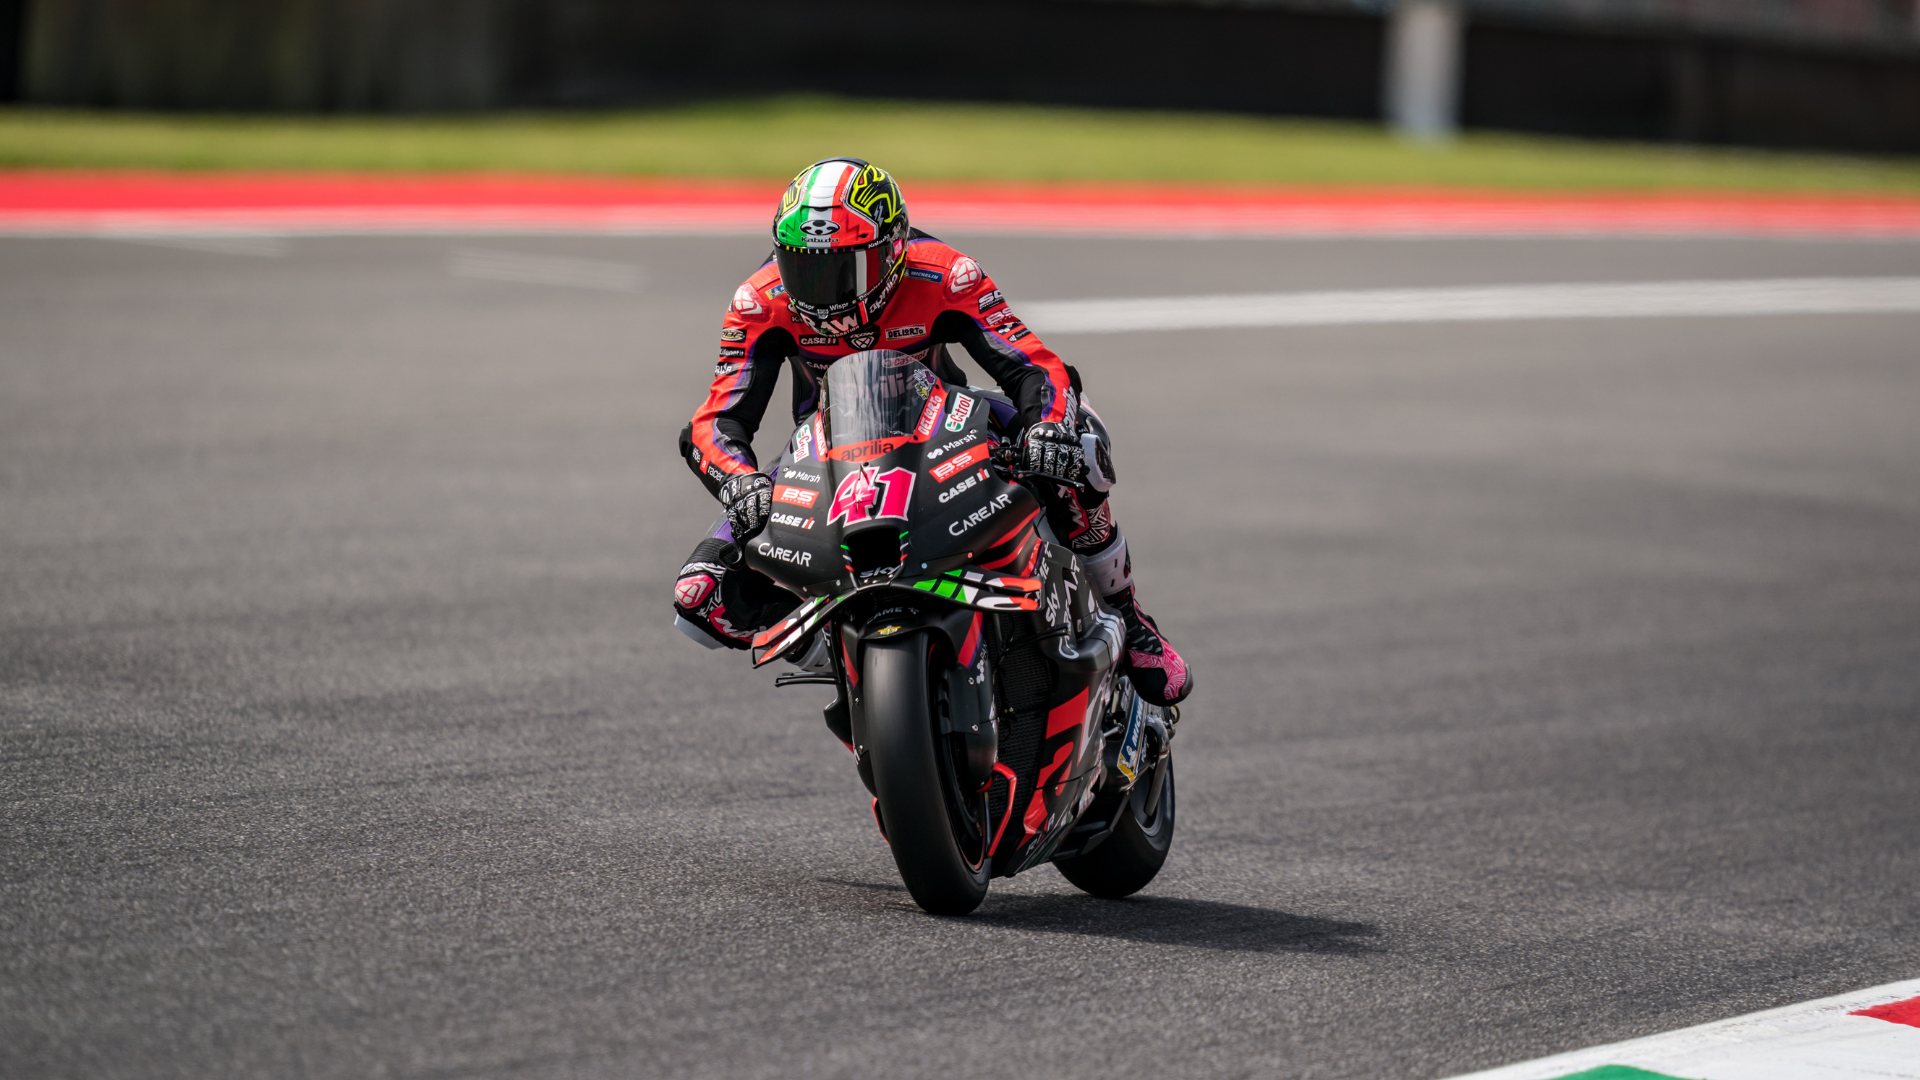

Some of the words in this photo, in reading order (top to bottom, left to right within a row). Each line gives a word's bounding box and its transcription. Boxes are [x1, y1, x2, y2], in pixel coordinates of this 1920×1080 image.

[829, 302, 849, 311] Wispr
[800, 337, 827, 345] CASE
[806, 361, 831, 370] CAM
[942, 434, 977, 451] Marsh
[841, 441, 894, 462] aprilia
[933, 452, 973, 478] BS
[707, 466, 724, 482] racer
[795, 471, 821, 483] Marsh
[782, 487, 816, 502] BS
[826, 466, 917, 528] 41
[938, 475, 977, 503] CASE
[770, 512, 803, 527] CASE
[948, 493, 1012, 536] CAREAR
[758, 542, 812, 567] CAREAR
